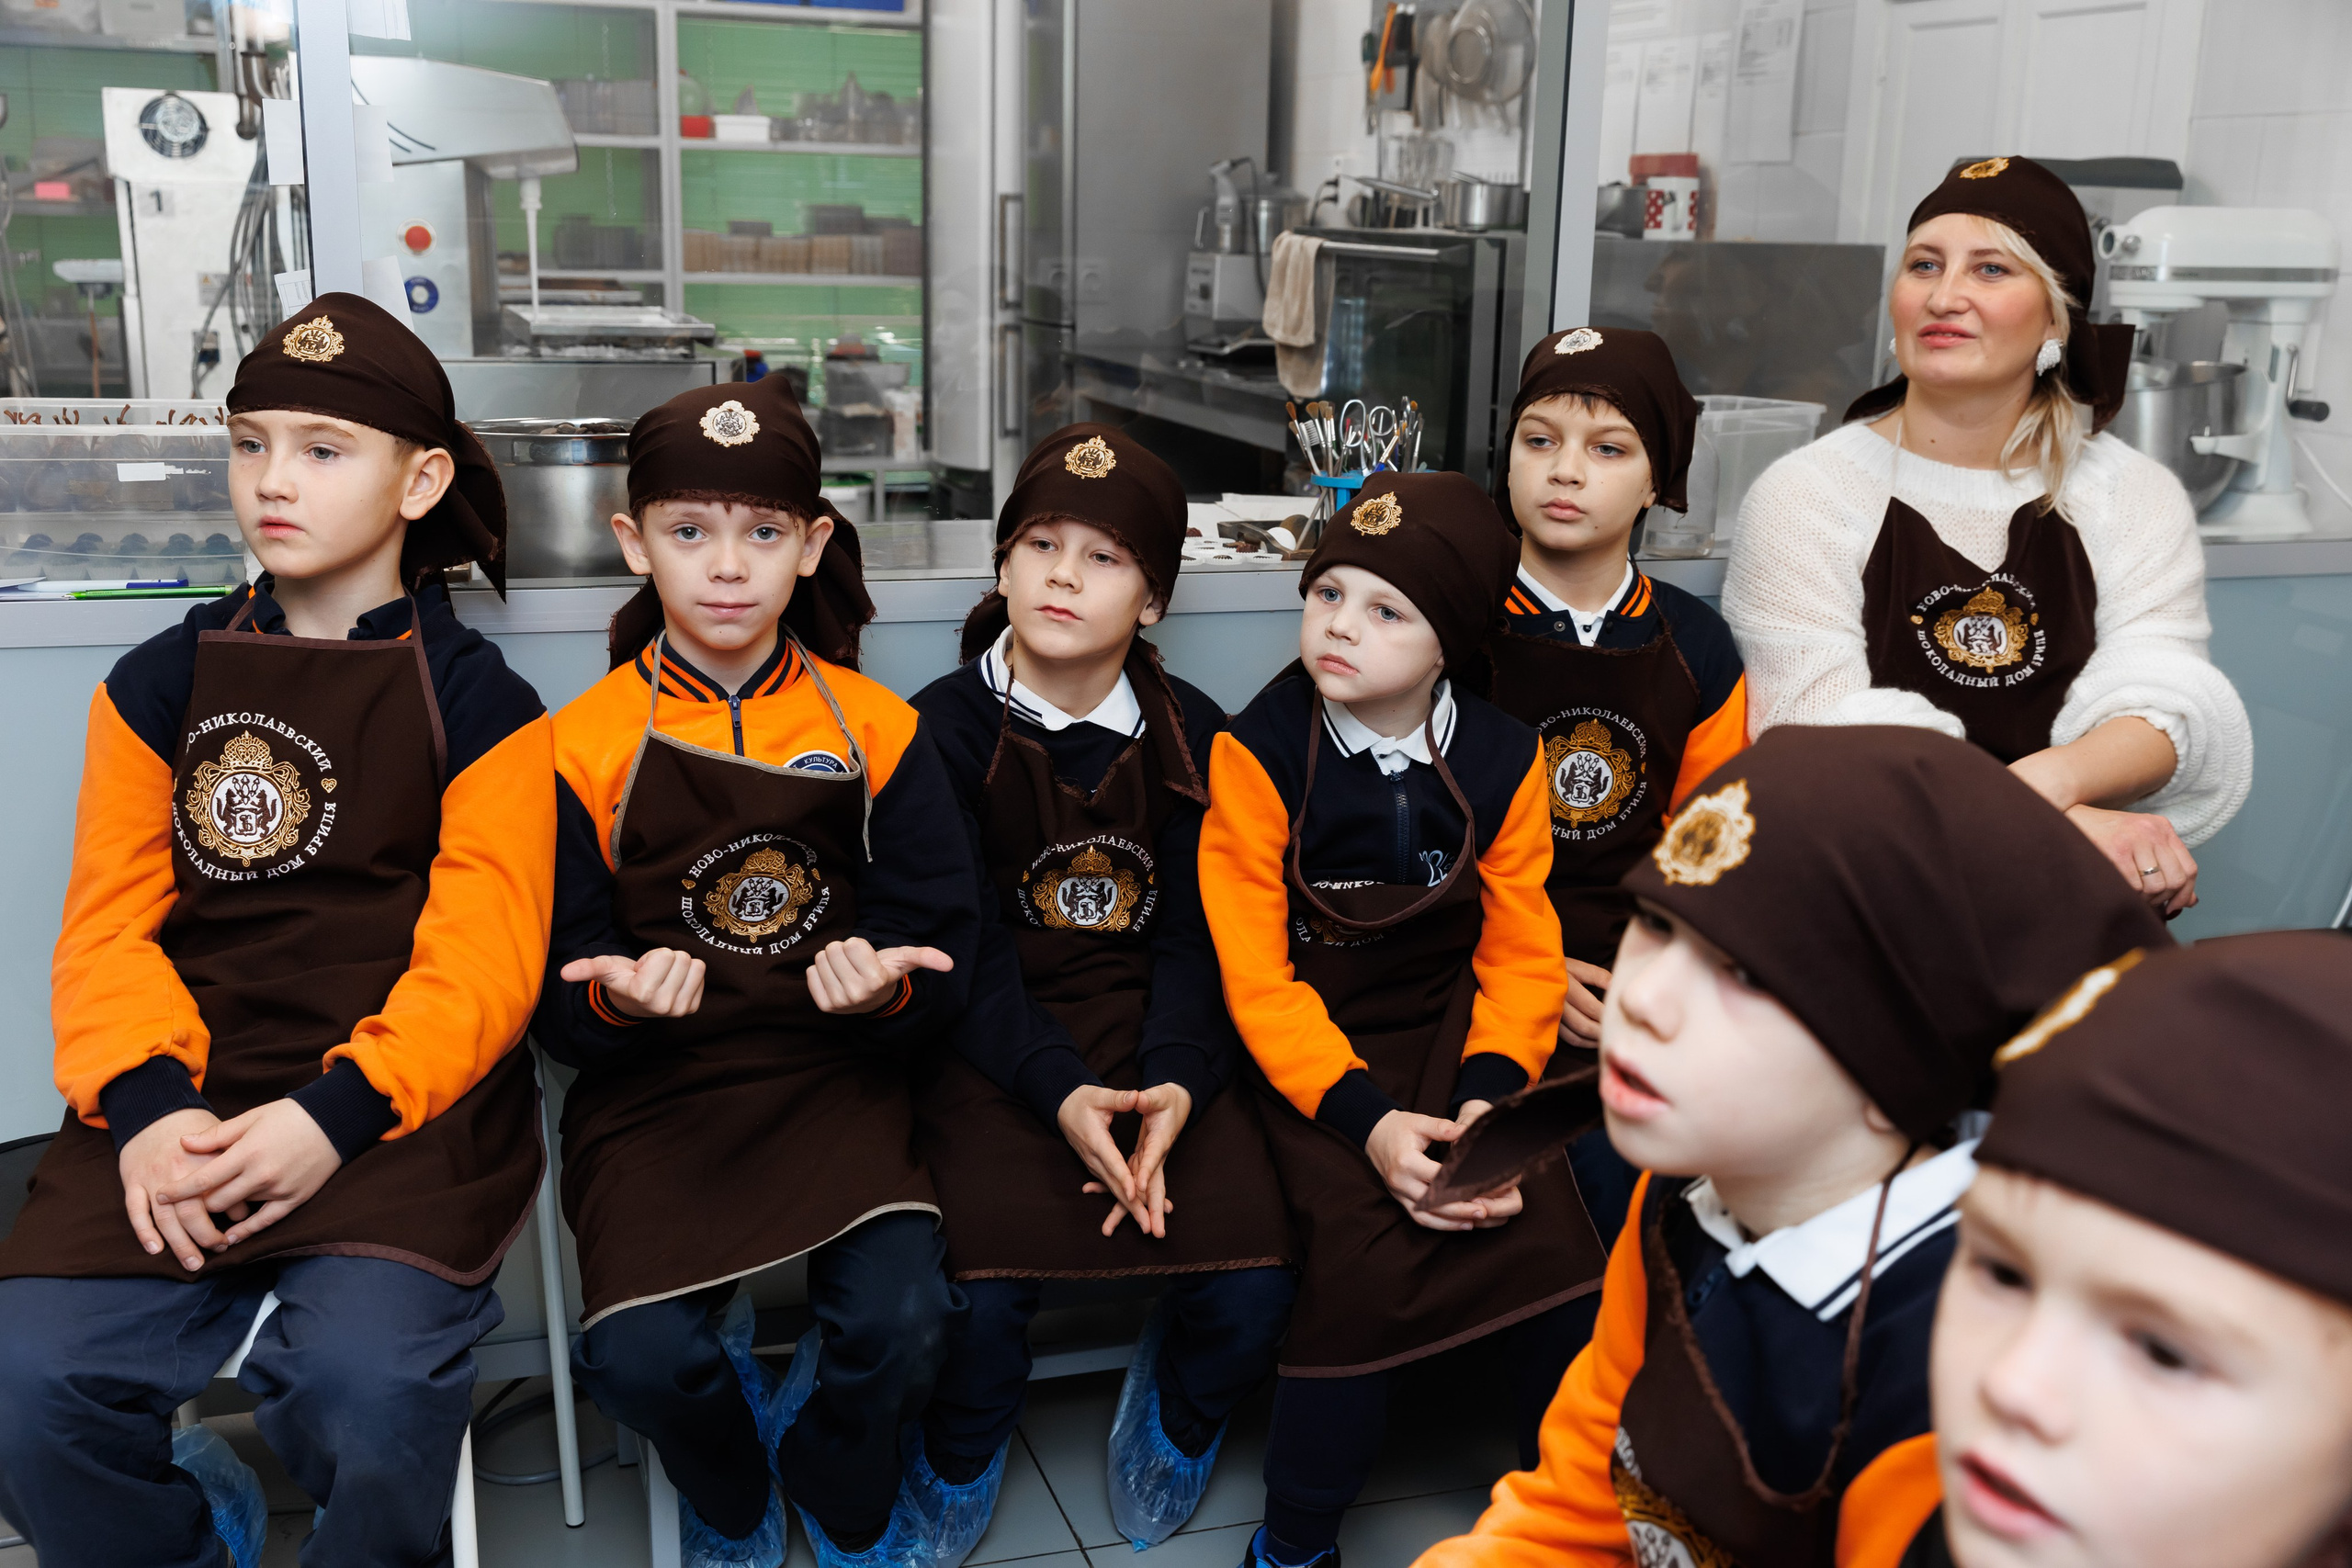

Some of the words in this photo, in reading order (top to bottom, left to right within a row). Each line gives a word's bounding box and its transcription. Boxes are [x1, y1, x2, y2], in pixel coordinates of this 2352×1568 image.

[1917, 629, 2000, 687] ШОКОЛАДНЫЙ
[2005, 664, 2035, 686] ДОМ
[186, 712, 333, 773] О-НИКОЛАЕВСКИЙ
[803, 756, 839, 770] КУЛЬТУРА
[1587, 820, 1617, 840] ДОМ
[1618, 781, 1647, 821] БРИЛЯ
[172, 801, 258, 881] ШОКОЛАДНЫЙ
[266, 854, 306, 879] ДОМ
[304, 801, 337, 856] БРИЛЯ
[681, 896, 763, 955] ШОКОЛАДНЫЙ
[769, 931, 802, 954] ДОМ
[802, 886, 831, 931] БРИЛЯ
[1132, 888, 1159, 932] БРИЛЯ
